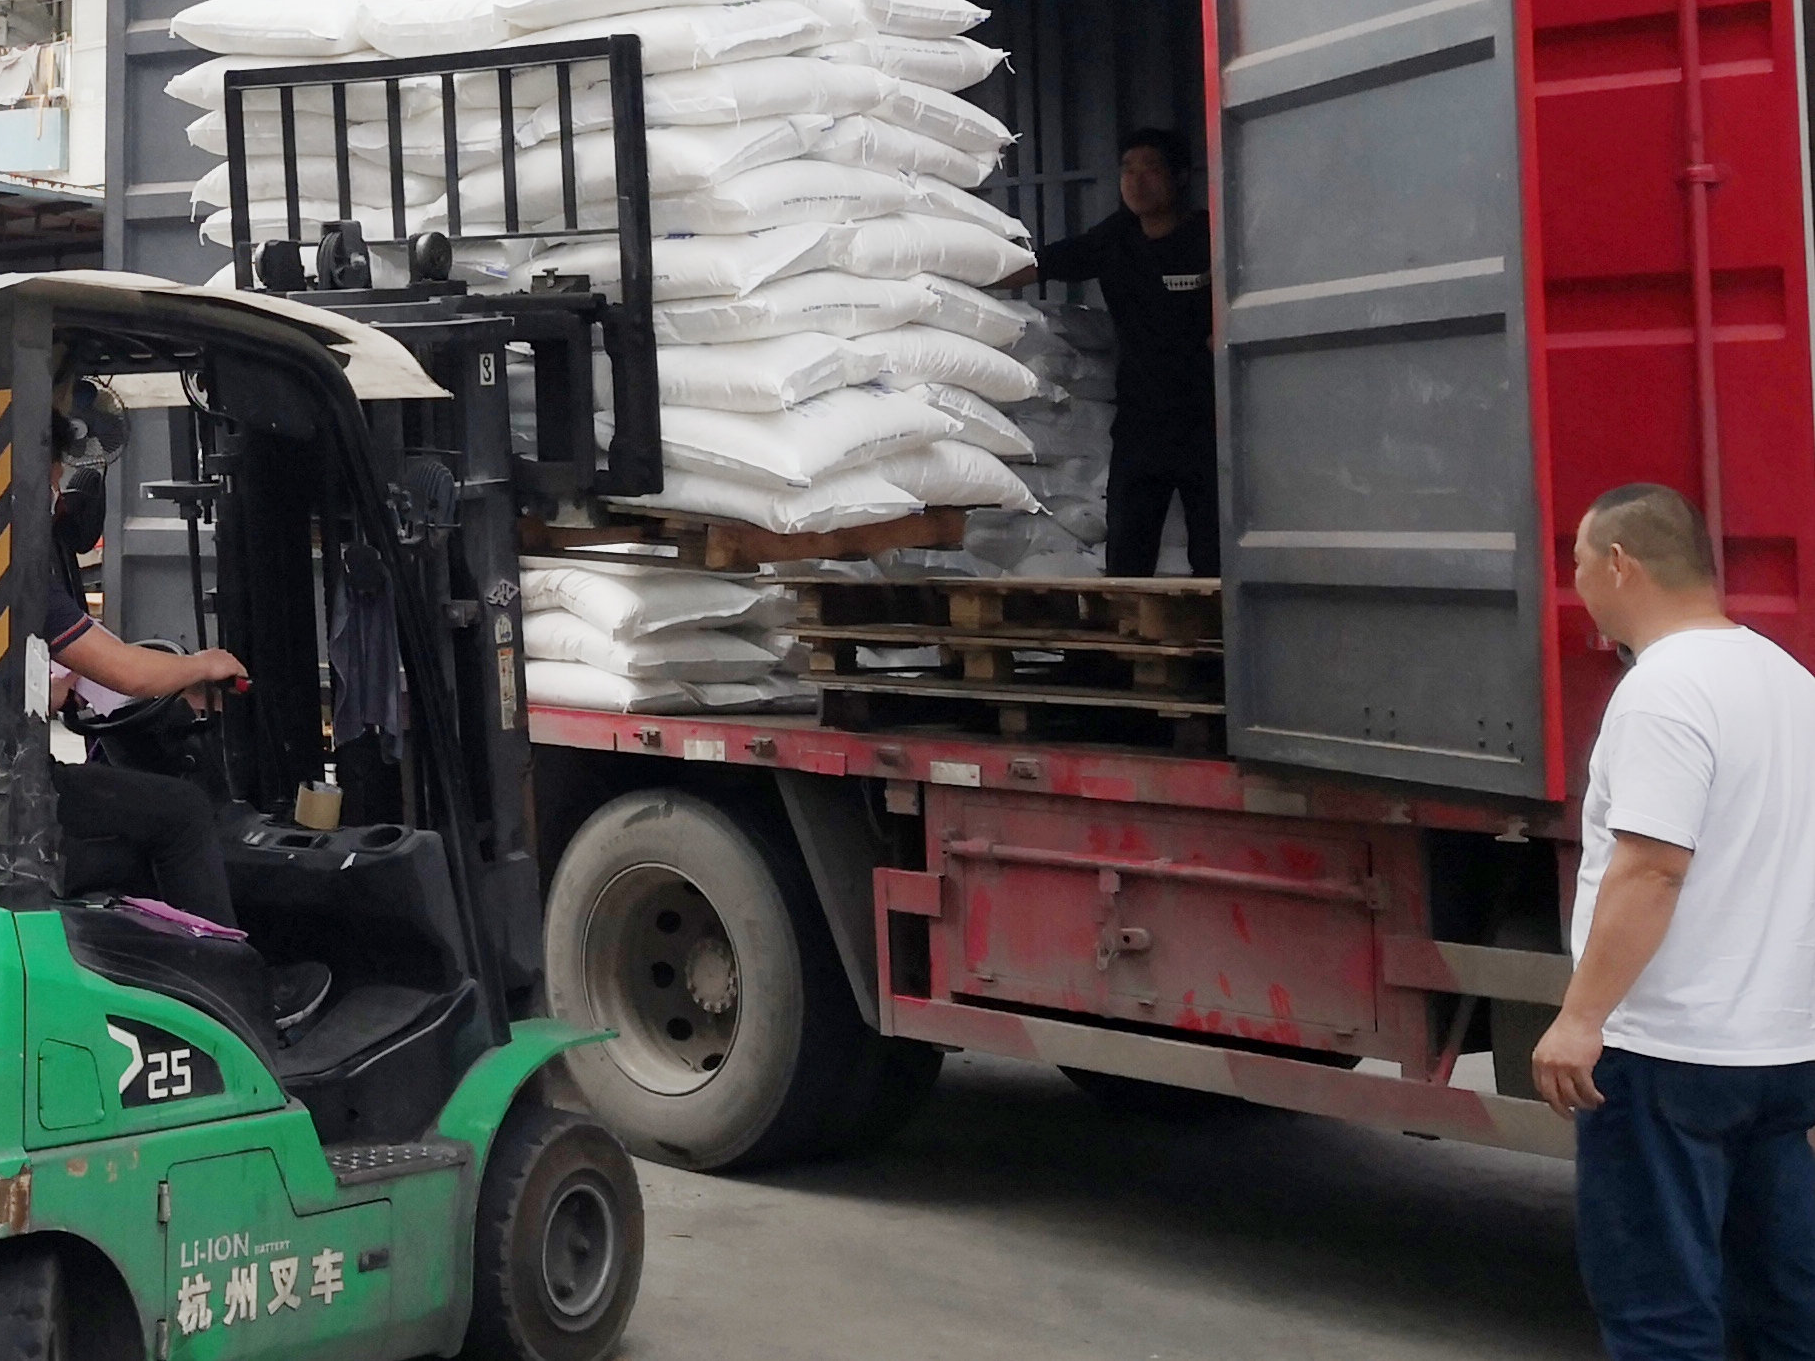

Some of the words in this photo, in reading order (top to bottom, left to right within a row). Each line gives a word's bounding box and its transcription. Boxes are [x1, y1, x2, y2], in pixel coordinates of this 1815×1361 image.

[147, 1048, 192, 1100] 25
[180, 1231, 249, 1268] Li-ION
[177, 1247, 345, 1336] 杭州叉车
